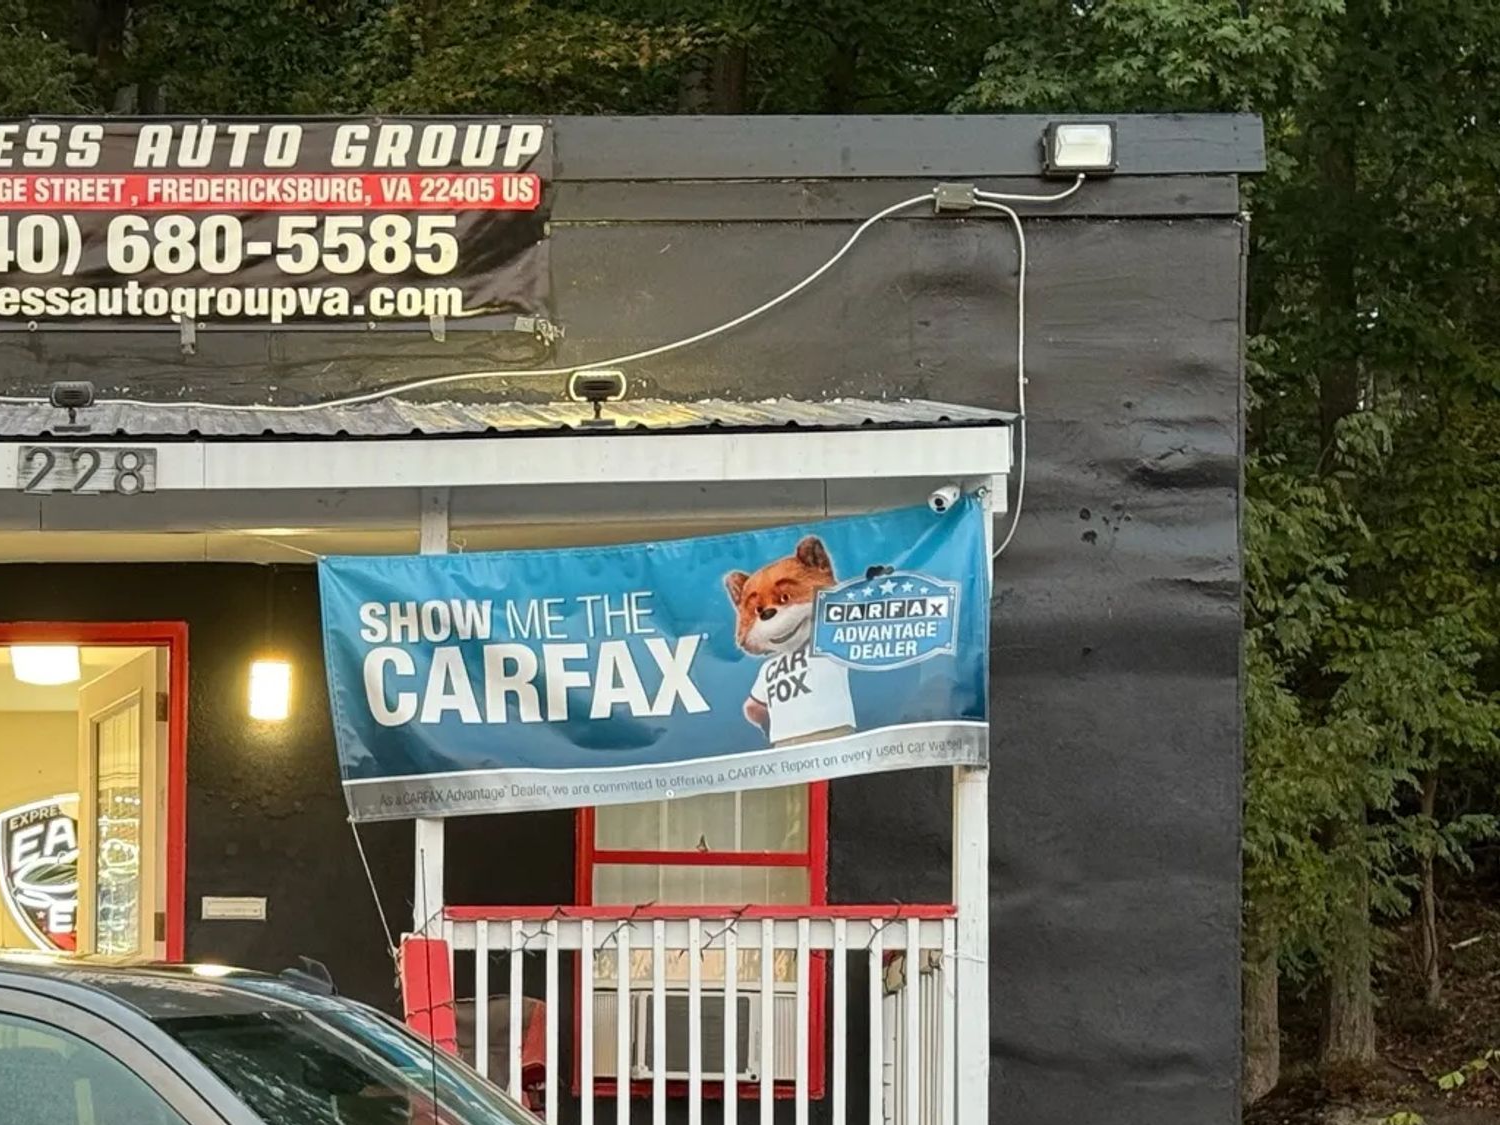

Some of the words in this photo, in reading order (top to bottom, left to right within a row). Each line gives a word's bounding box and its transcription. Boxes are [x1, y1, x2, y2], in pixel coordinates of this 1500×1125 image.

[134, 124, 302, 168] AUTO
[331, 124, 543, 168] GROUP
[147, 178, 372, 207] FREDERICKSBURG,
[380, 178, 413, 203] VA
[420, 178, 495, 203] 22405
[503, 177, 535, 203] US
[106, 214, 459, 275] 680-5585
[23, 446, 146, 496] 228
[359, 599, 494, 644] SHOW
[506, 597, 568, 640] ME
[576, 591, 656, 638] THE
[827, 598, 946, 624] CARFAX
[832, 621, 938, 644] ADVANTAGE
[849, 641, 917, 660] DEALER
[362, 633, 711, 728] CARFAX
[764, 650, 807, 684] CAR
[766, 671, 811, 707] FOX
[404, 790, 444, 806] CARFAX
[511, 784, 550, 798] Dealer,
[552, 785, 569, 796] we
[572, 785, 591, 796] are
[593, 779, 653, 794] committed
[655, 777, 666, 788] to
[669, 772, 714, 787] offering
[717, 774, 725, 783] a
[780, 756, 820, 774] Report
[823, 756, 838, 767] on
[842, 749, 873, 764] every
[876, 743, 904, 758] used
[907, 741, 926, 754] car
[8, 804, 64, 832] EXPRE
[10, 816, 77, 872] EA
